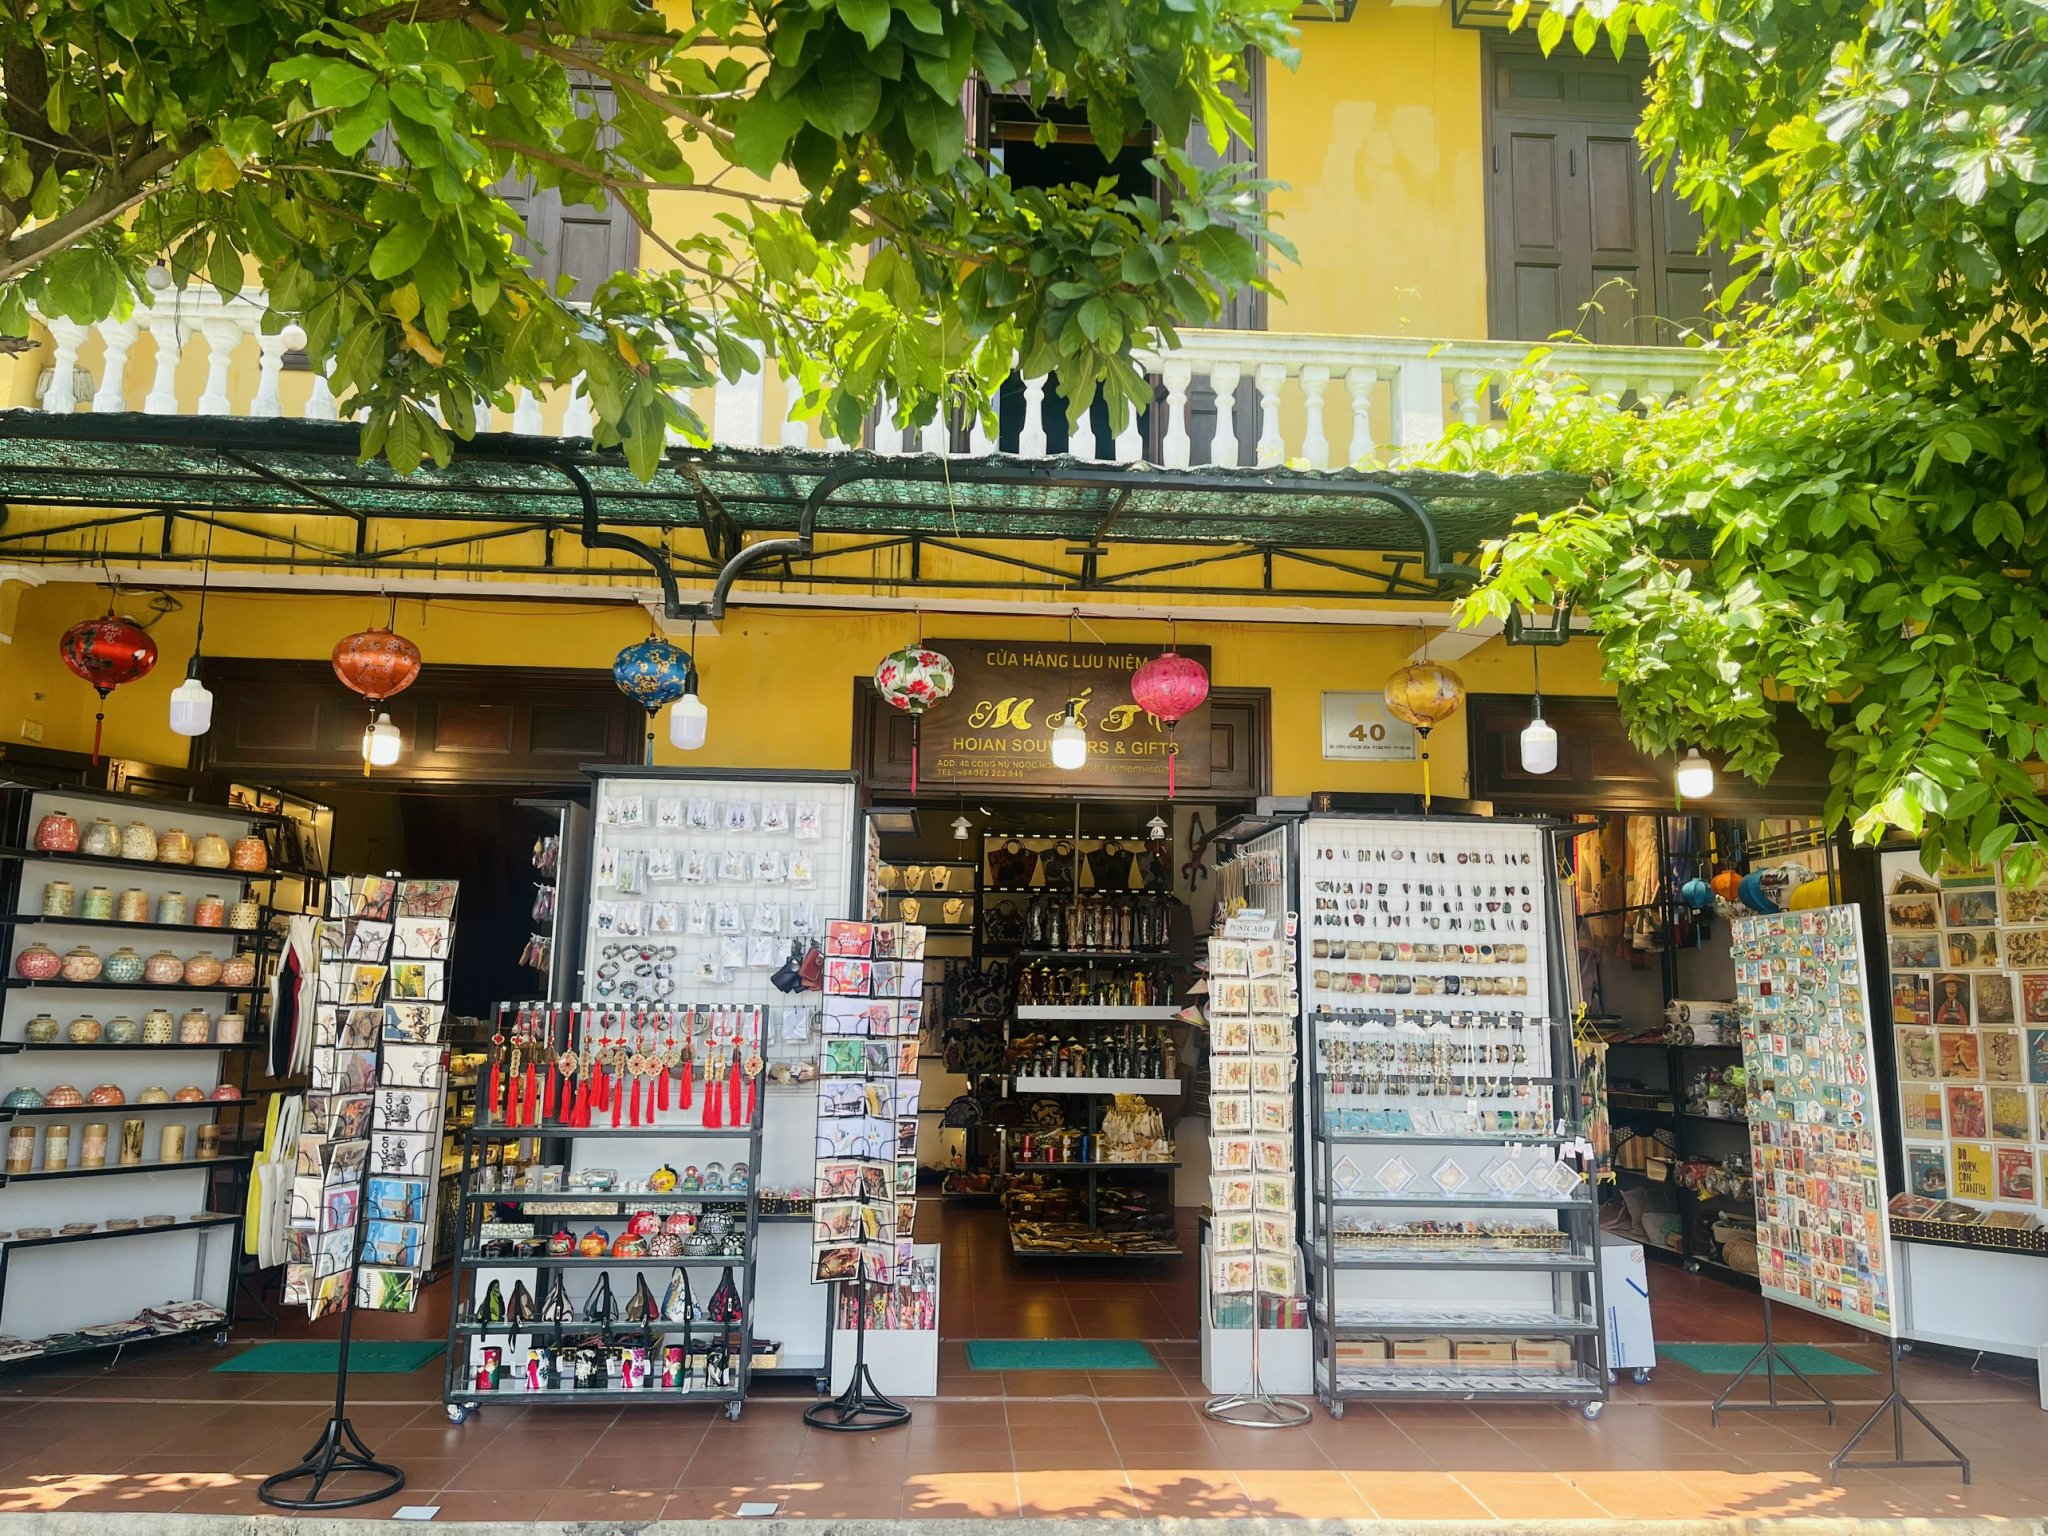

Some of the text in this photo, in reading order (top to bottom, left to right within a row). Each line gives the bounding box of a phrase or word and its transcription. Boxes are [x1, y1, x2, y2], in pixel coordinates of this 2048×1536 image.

[986, 648, 1148, 672] CỬA HÀNG LƯU NIỆM
[1348, 724, 1386, 742] 40
[953, 737, 1180, 756] HOIAN SOURS & GIFTS
[1230, 924, 1270, 933] POSTCARD
[384, 1092, 393, 1126] SAIGON
[381, 1136, 390, 1170] SAIGON
[1957, 1147, 1967, 1160] DO
[1959, 1172, 1972, 1182] CON
